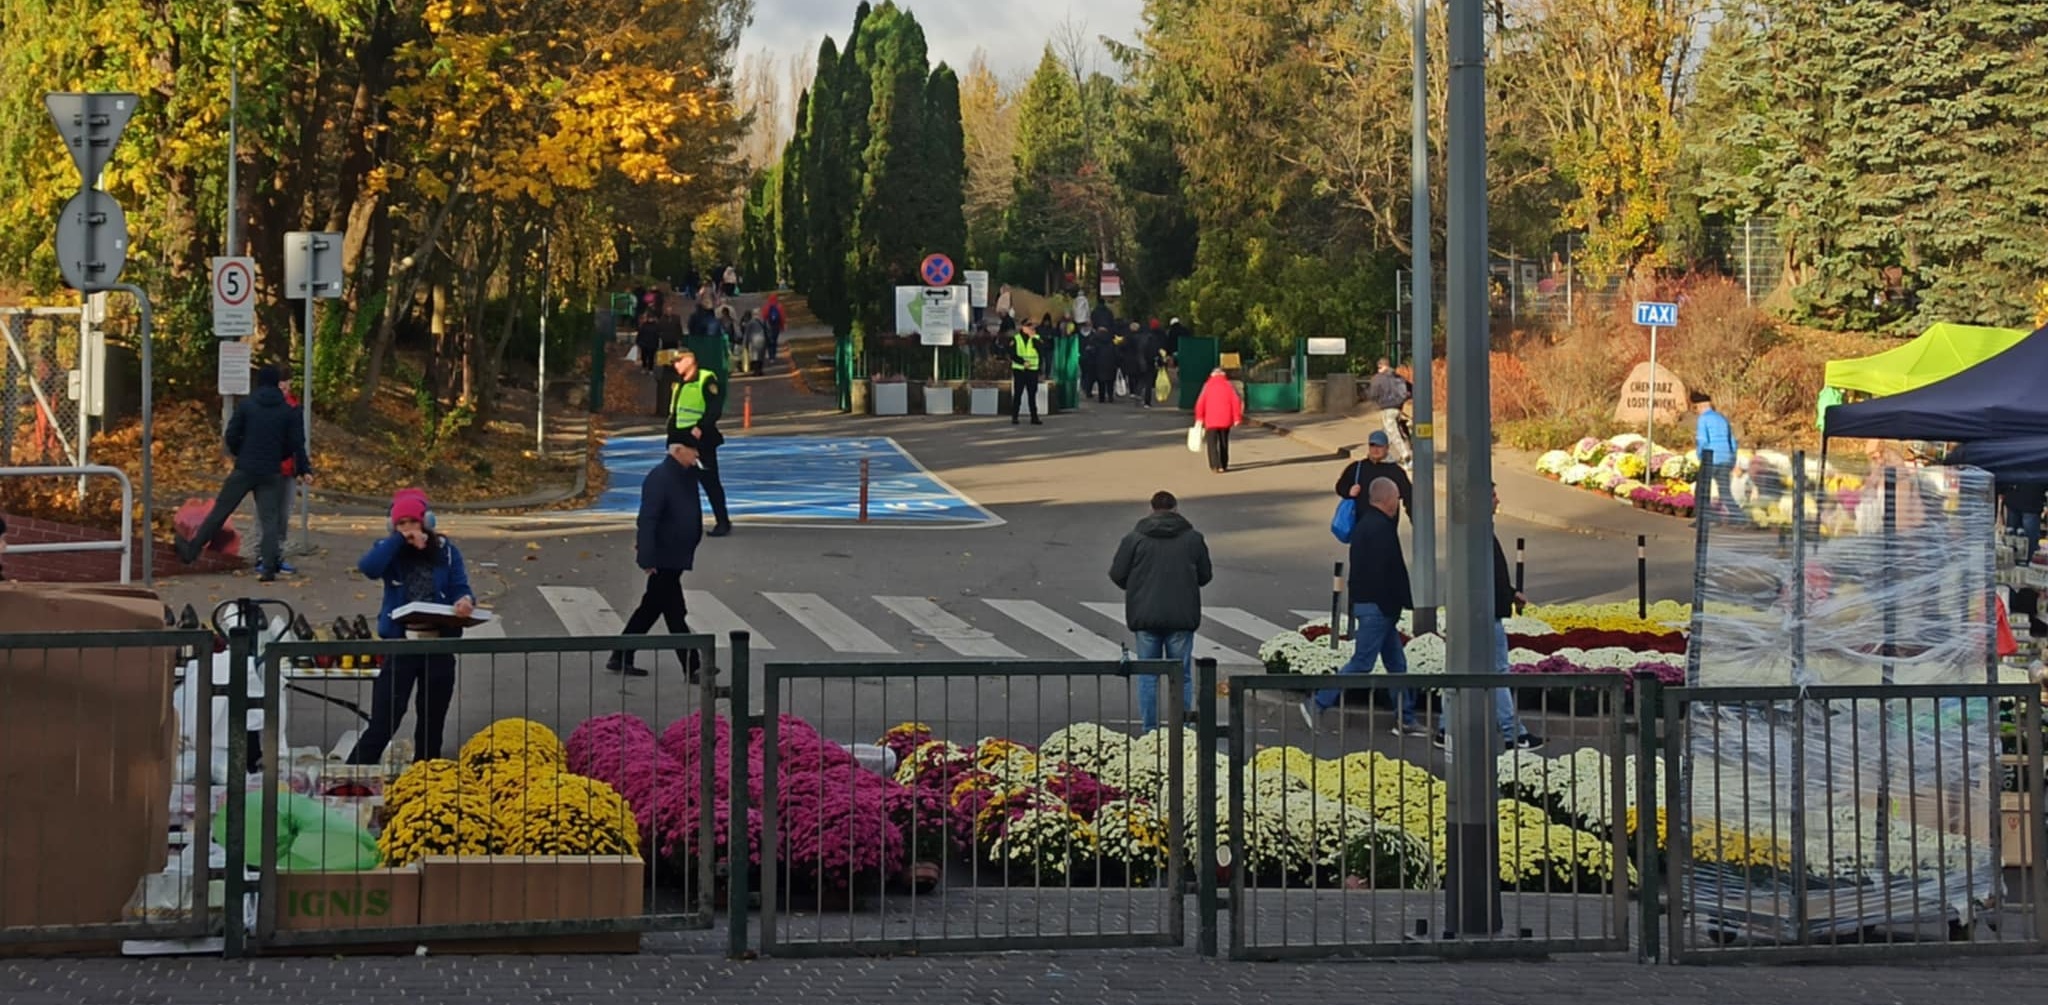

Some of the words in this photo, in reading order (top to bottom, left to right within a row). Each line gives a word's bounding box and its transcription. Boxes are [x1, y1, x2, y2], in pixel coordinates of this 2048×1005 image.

[227, 271, 239, 296] 5
[1640, 305, 1675, 323] TAXI
[289, 890, 390, 917] IGNIS
